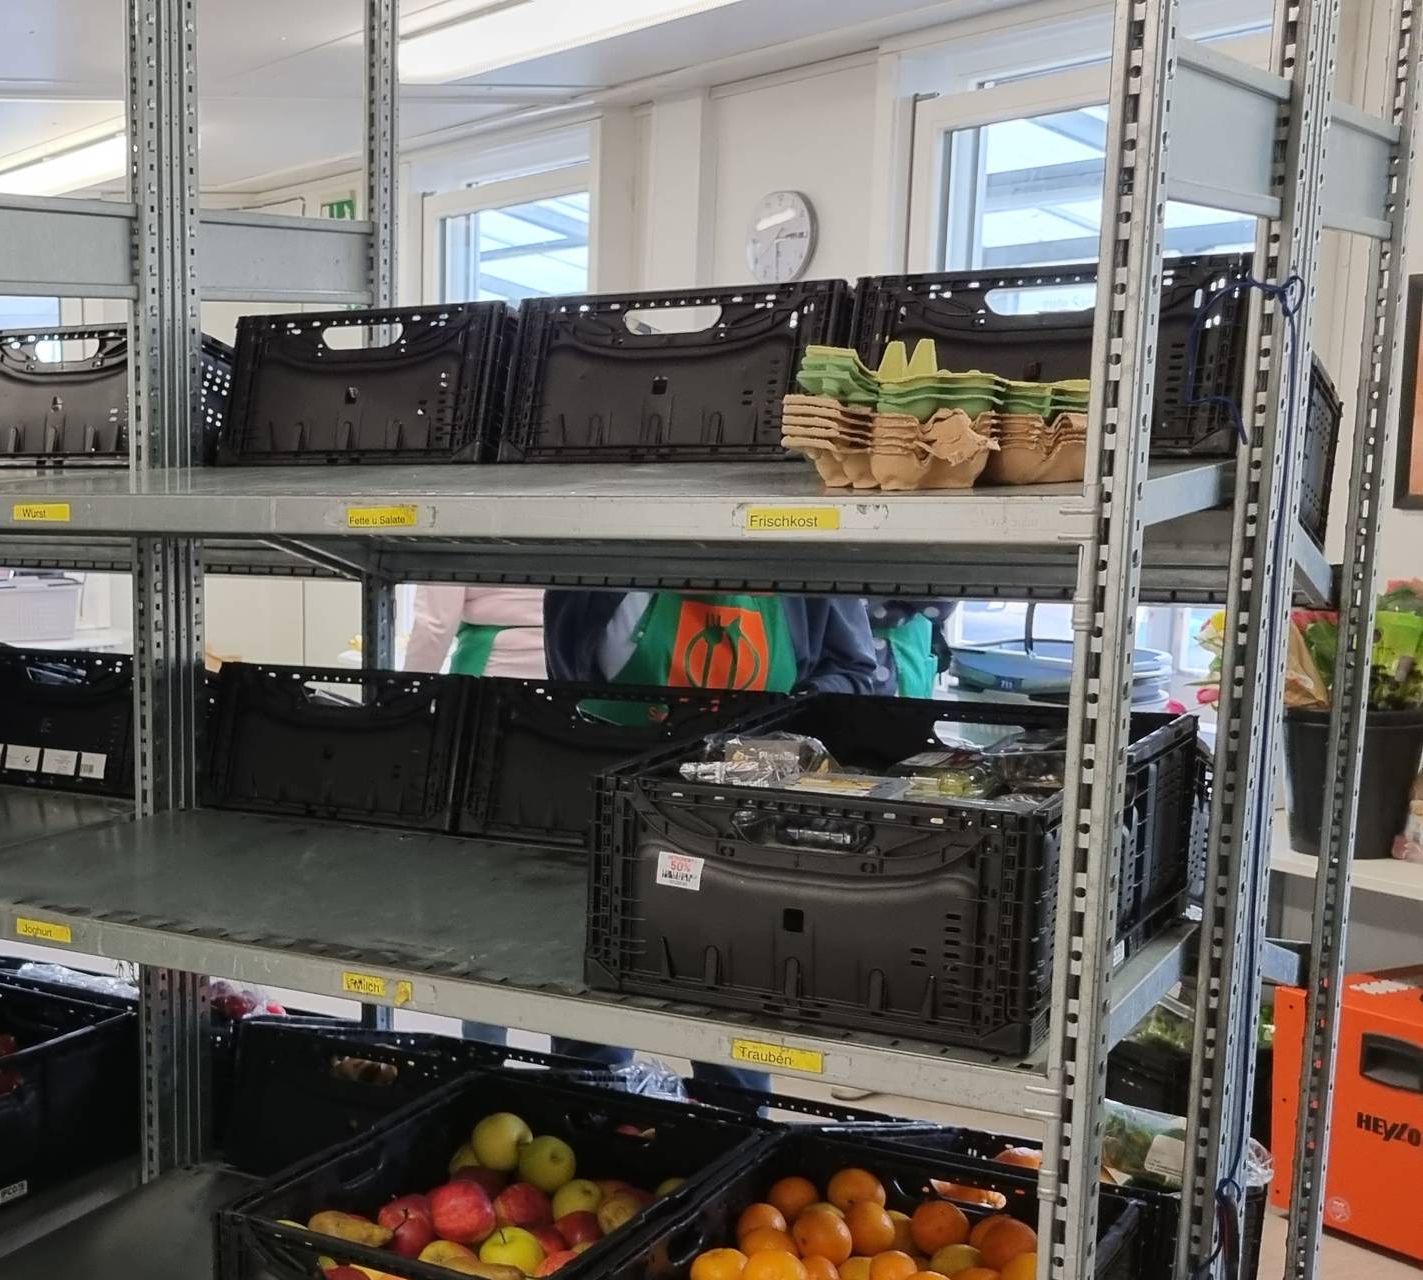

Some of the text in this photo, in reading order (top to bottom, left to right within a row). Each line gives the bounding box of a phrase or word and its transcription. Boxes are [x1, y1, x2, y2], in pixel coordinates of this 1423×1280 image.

[21, 506, 47, 519] Wurst
[349, 515, 370, 525] Fette
[379, 514, 406, 525] Salate
[749, 513, 819, 528] Frischkost
[21, 923, 54, 938] Joghurt
[738, 1045, 794, 1066] Trauben
[1356, 1111, 1422, 1148] HEYLO
